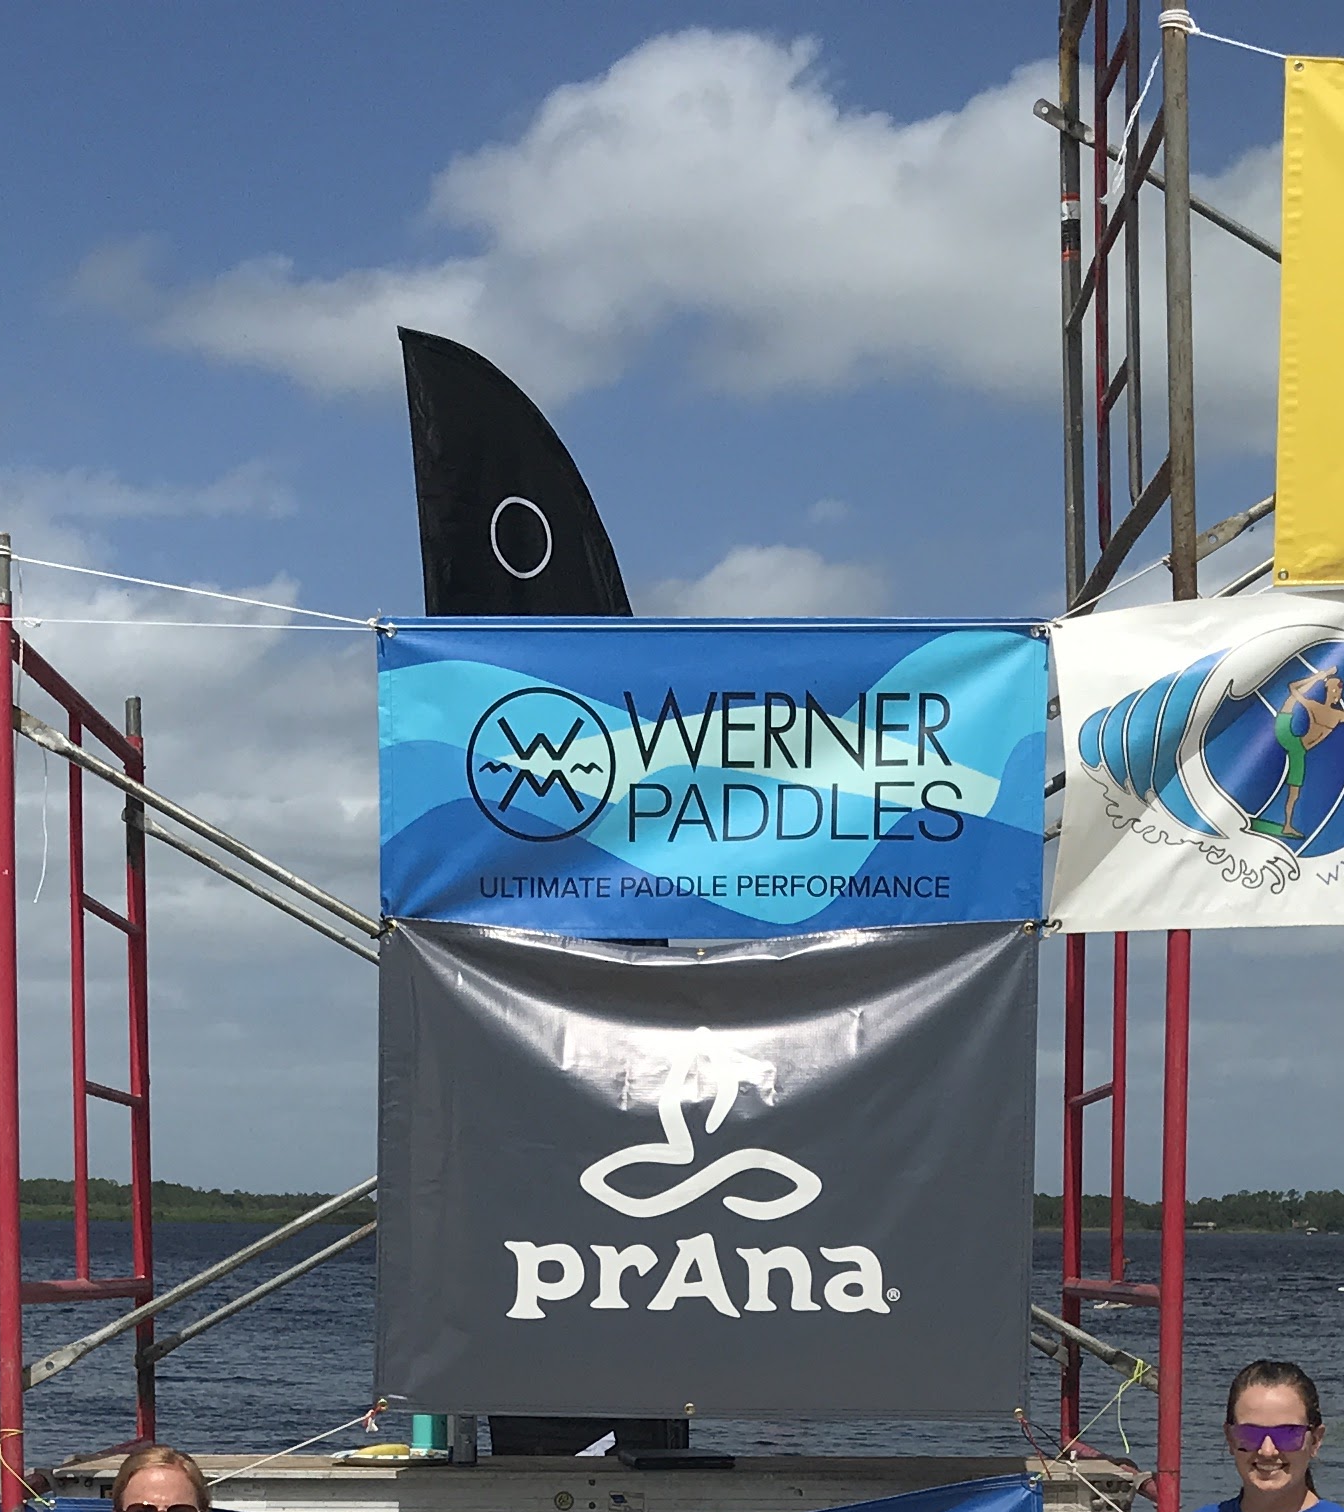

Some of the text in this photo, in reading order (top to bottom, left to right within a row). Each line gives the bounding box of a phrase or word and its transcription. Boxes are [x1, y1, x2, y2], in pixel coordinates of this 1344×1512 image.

[624, 686, 952, 772] WERNER
[628, 780, 965, 843] PADDLES
[479, 874, 951, 899] ULTIMATE PADDLE PERFORMANCE
